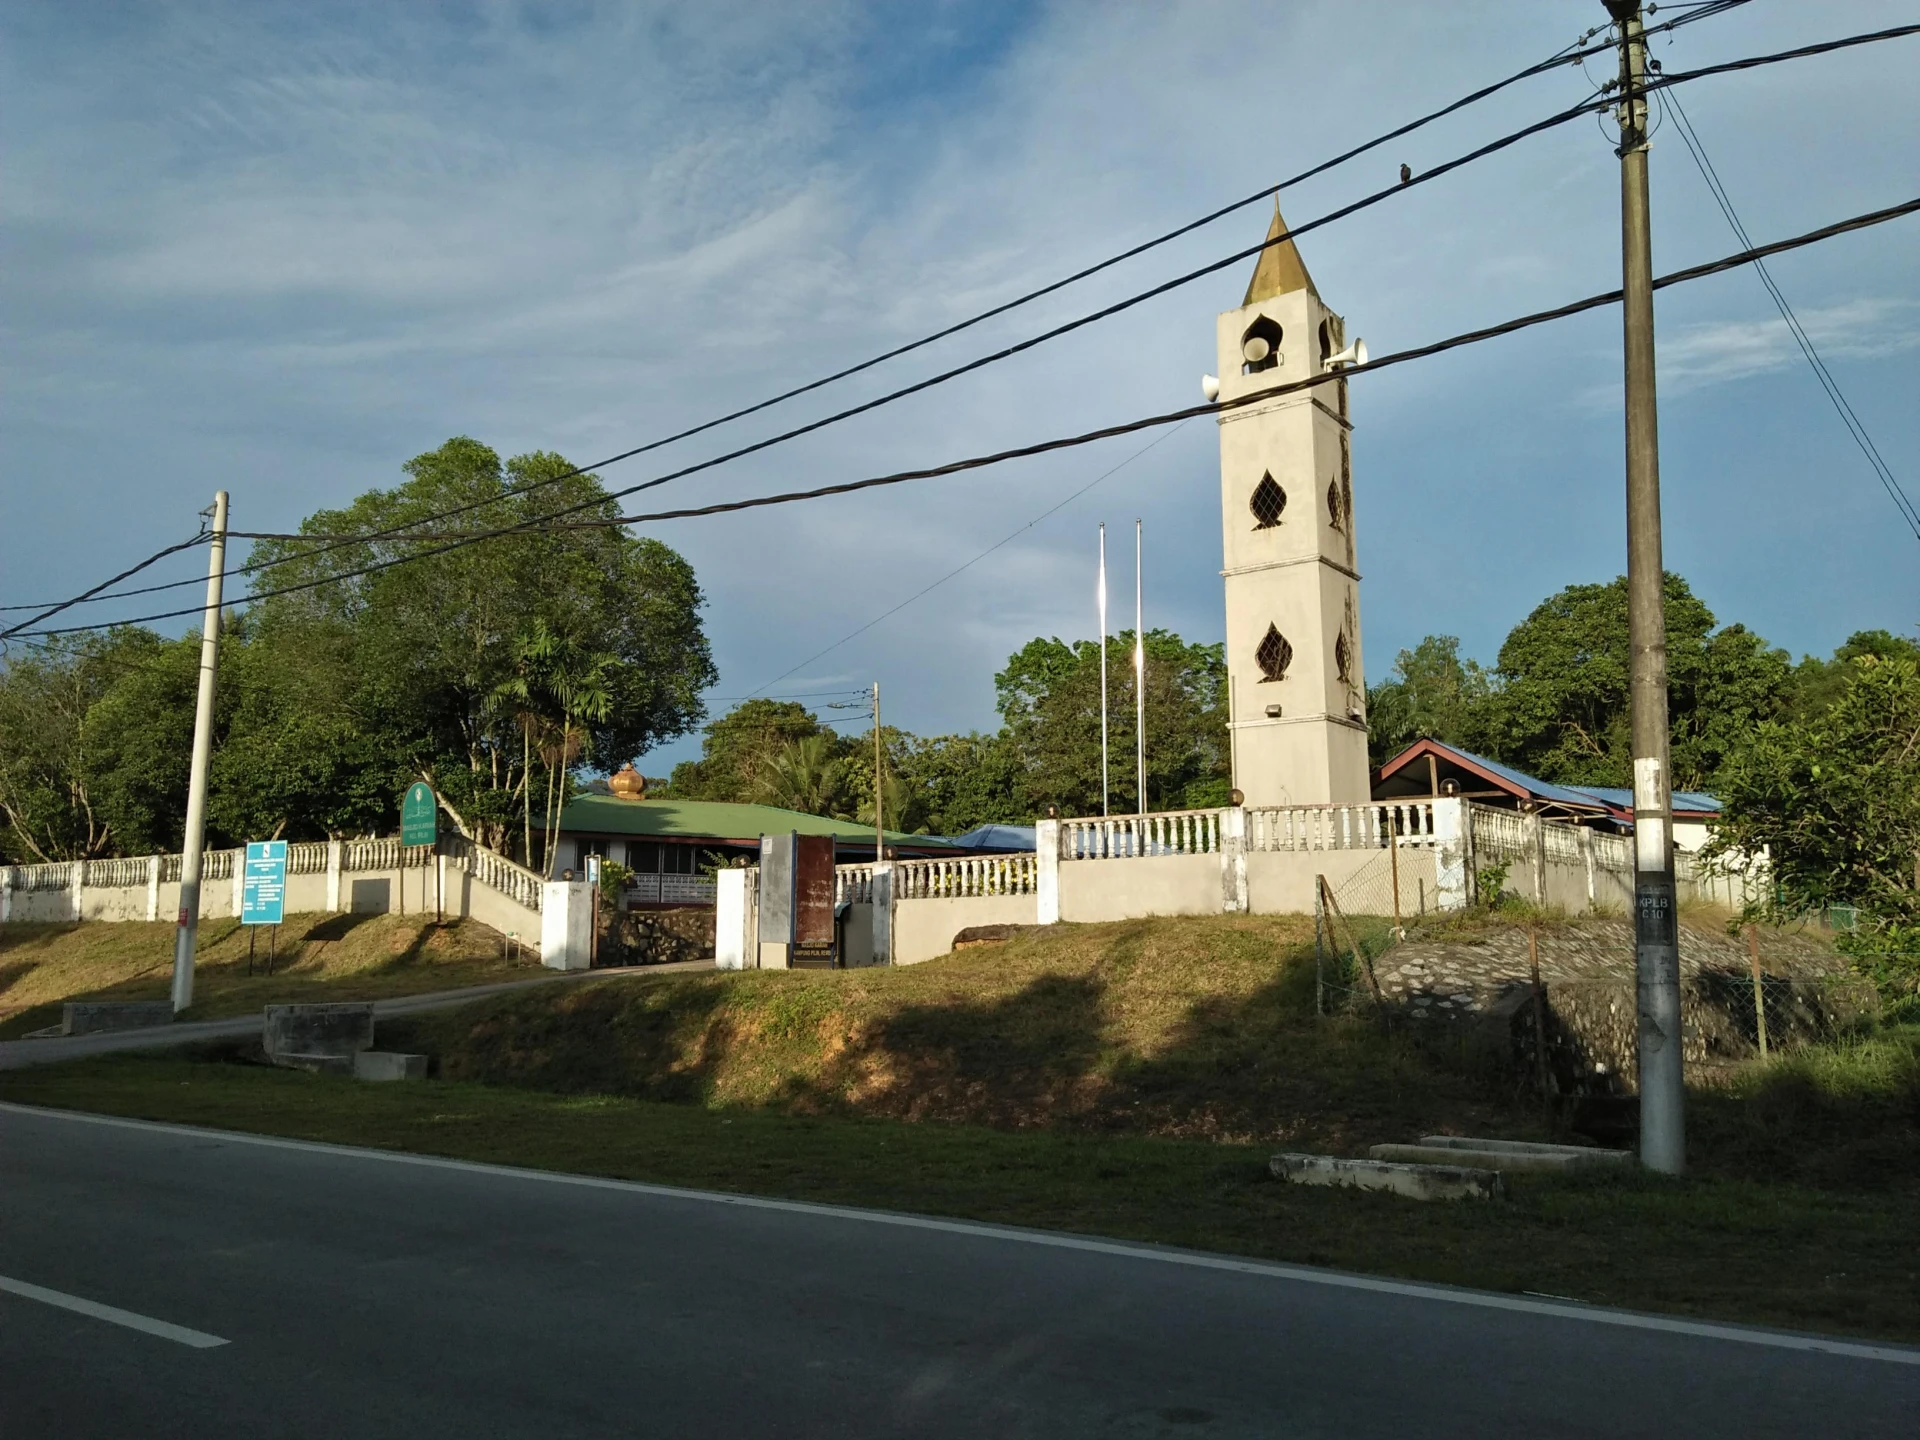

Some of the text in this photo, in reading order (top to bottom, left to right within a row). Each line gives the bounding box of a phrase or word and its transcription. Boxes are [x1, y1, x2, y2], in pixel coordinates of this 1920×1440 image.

[1639, 897, 1668, 908] KPLB
[1642, 909, 1663, 919] C 10
